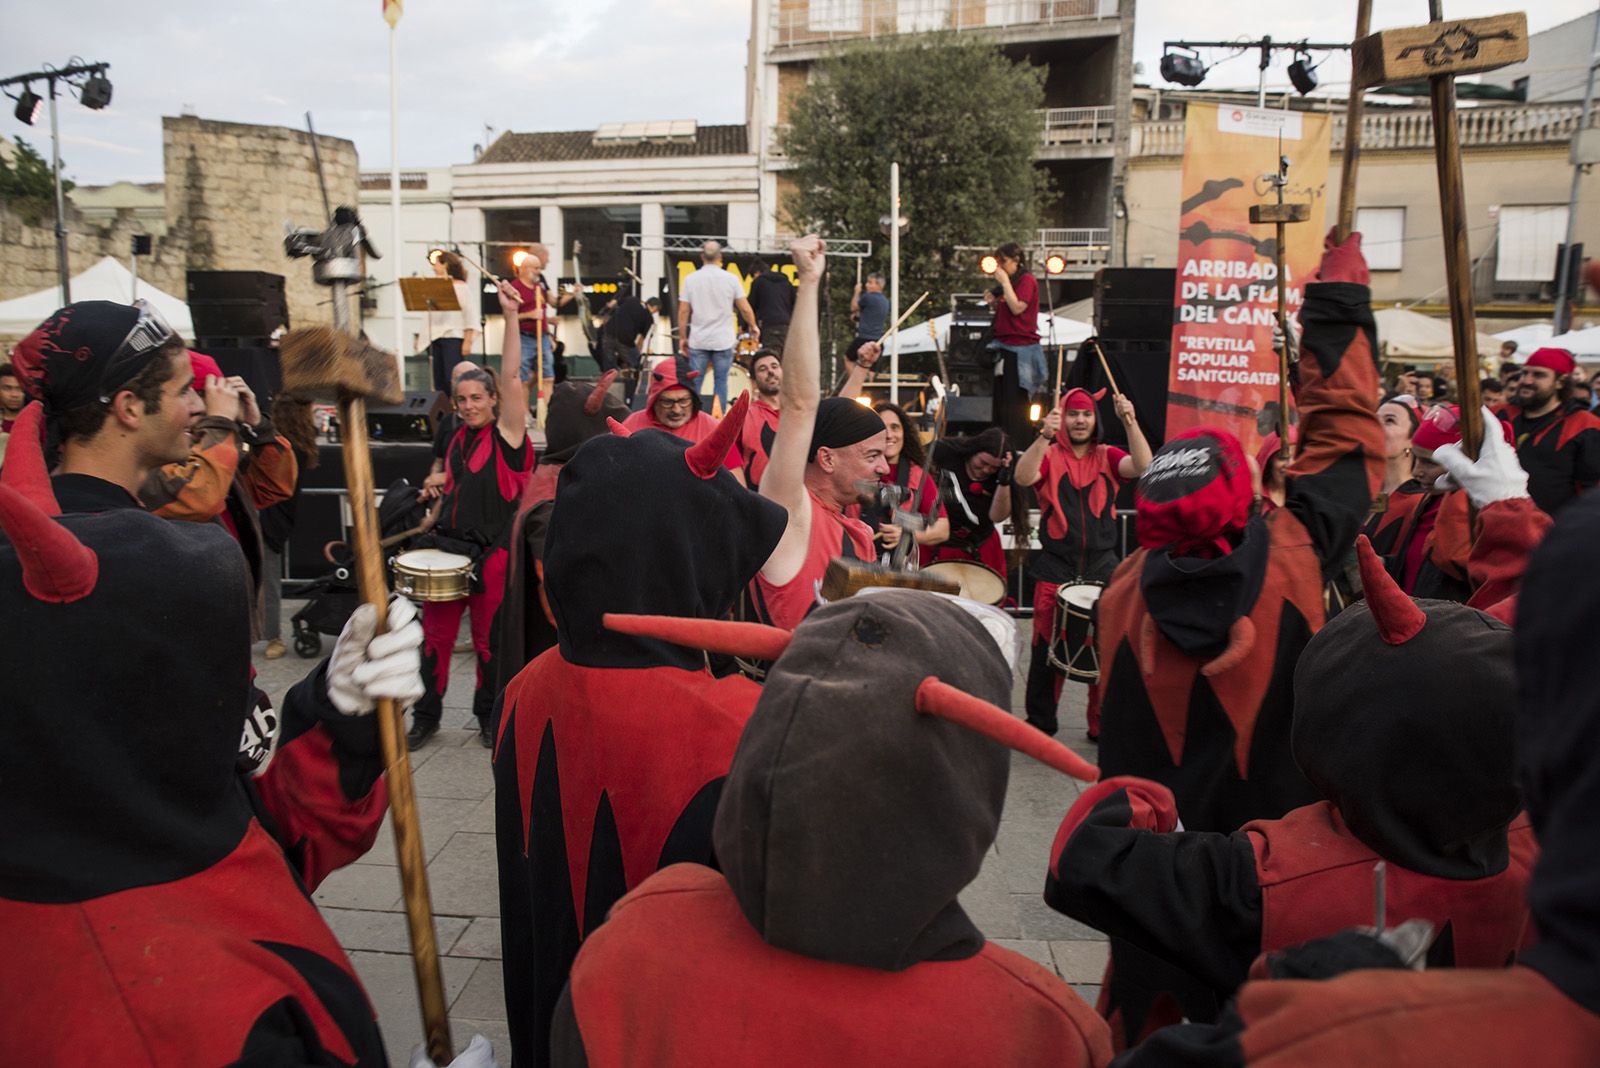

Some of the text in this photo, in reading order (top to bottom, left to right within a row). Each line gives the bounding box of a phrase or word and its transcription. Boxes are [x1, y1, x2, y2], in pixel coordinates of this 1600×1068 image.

[1181, 281, 1304, 305] DE LA FLAM
[1179, 304, 1218, 323] DEL
[1179, 335, 1256, 352] "REVETLLA
[1178, 352, 1249, 368] POPULAR
